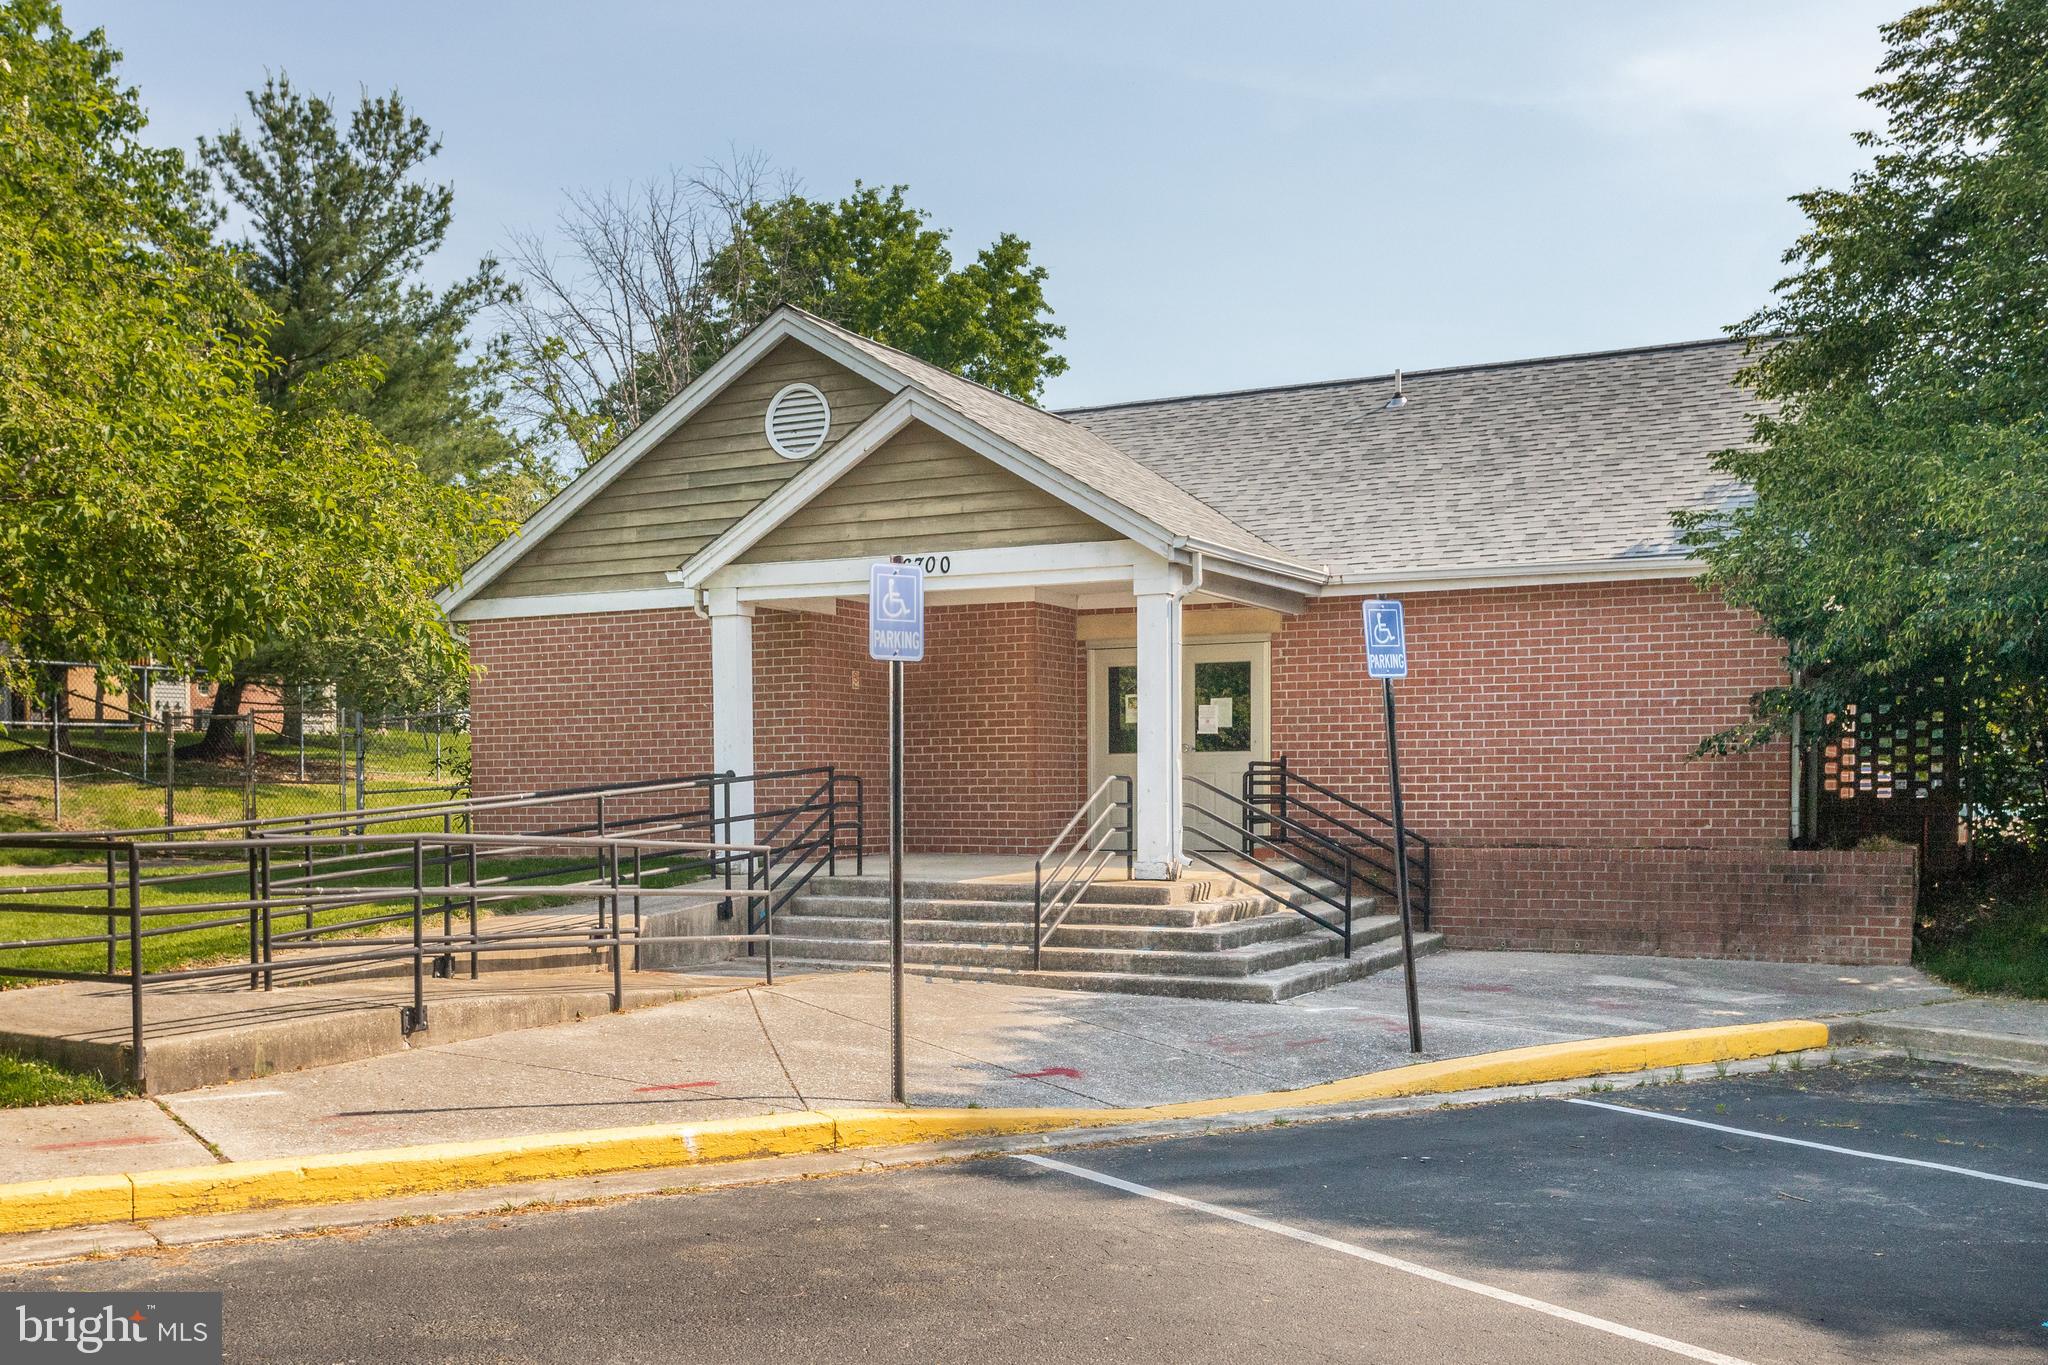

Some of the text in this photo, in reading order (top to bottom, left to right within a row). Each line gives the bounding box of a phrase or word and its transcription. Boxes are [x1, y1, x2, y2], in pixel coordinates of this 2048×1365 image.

[903, 556, 951, 574] 700
[874, 630, 920, 649] PARKING
[1370, 653, 1405, 669] PARKING
